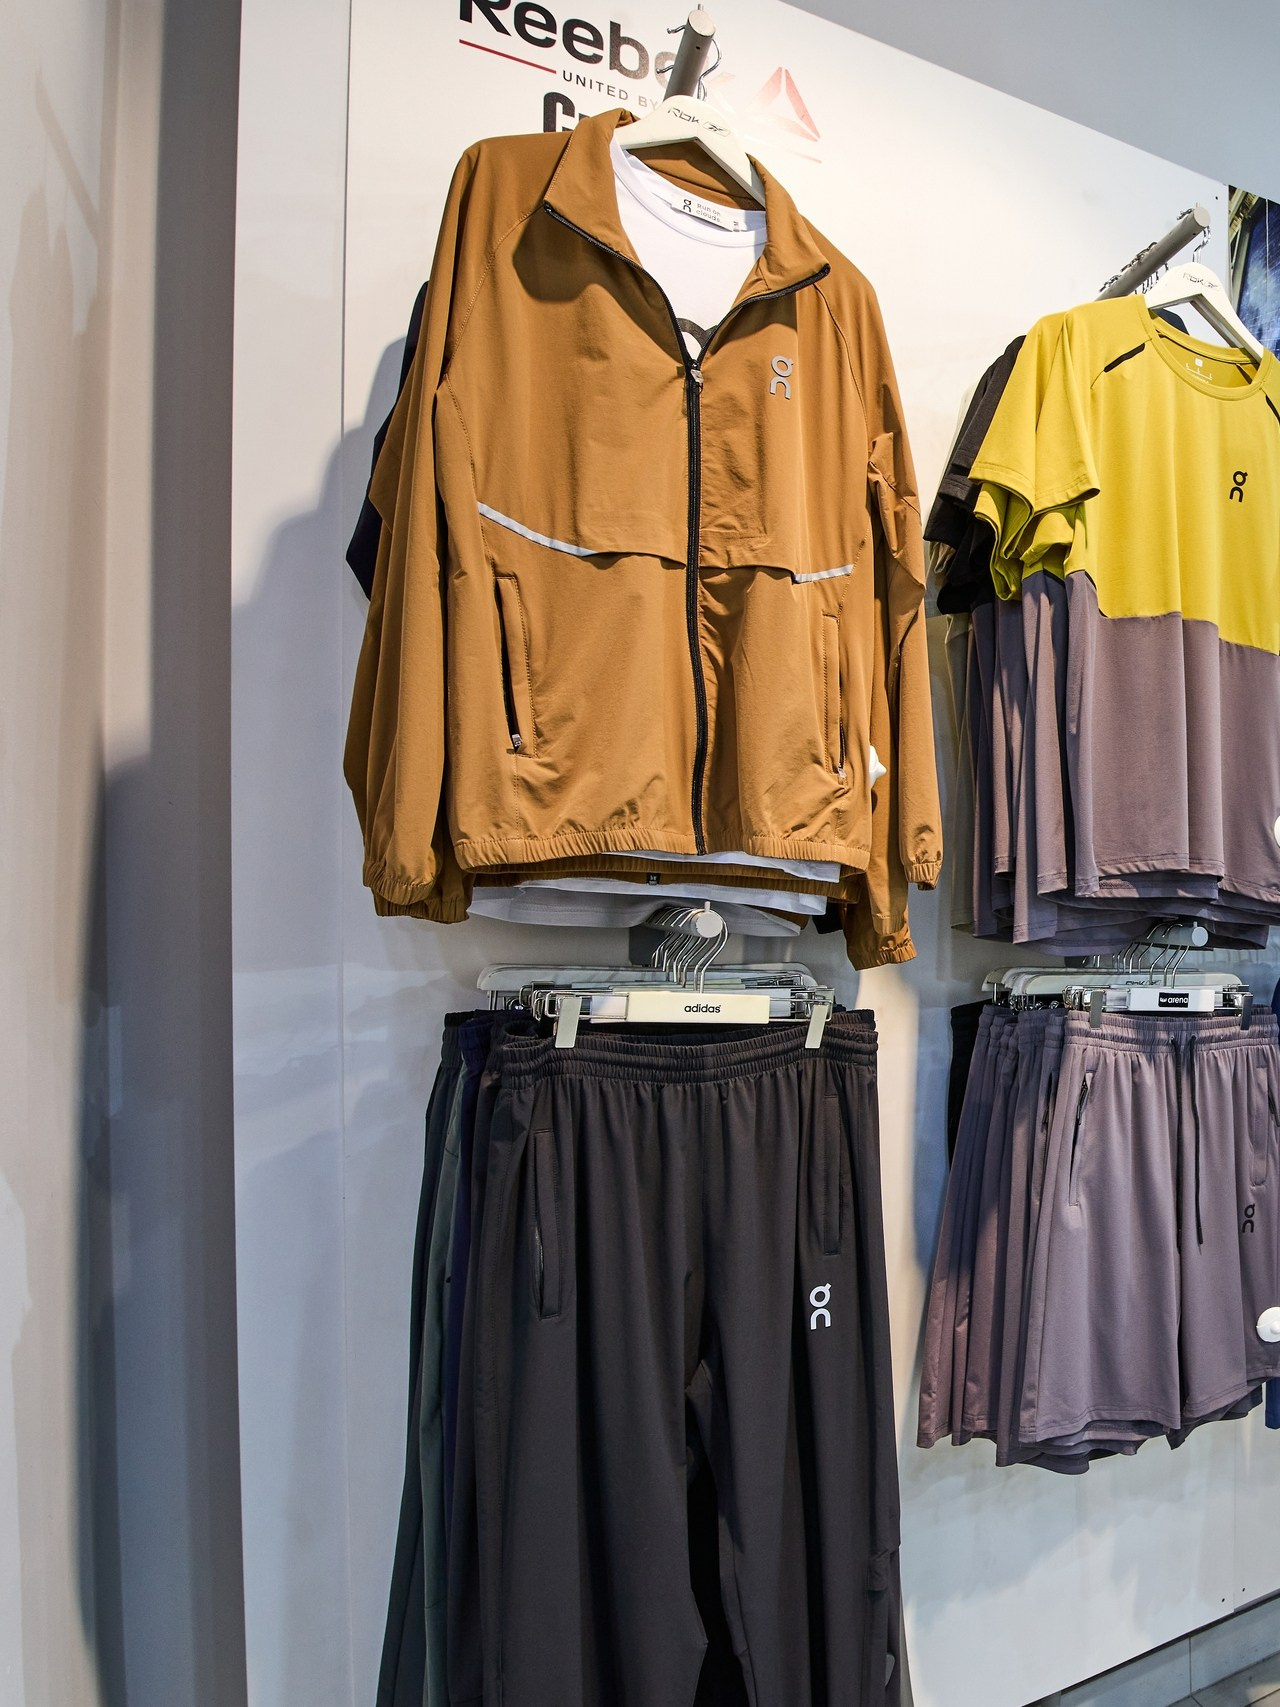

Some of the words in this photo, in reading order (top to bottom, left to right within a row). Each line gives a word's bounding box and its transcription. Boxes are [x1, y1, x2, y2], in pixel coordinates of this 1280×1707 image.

[562, 70, 629, 101] UNITED
[638, 96, 658, 111] BY
[1167, 996, 1189, 1004] arena
[684, 1003, 721, 1014] adidas
